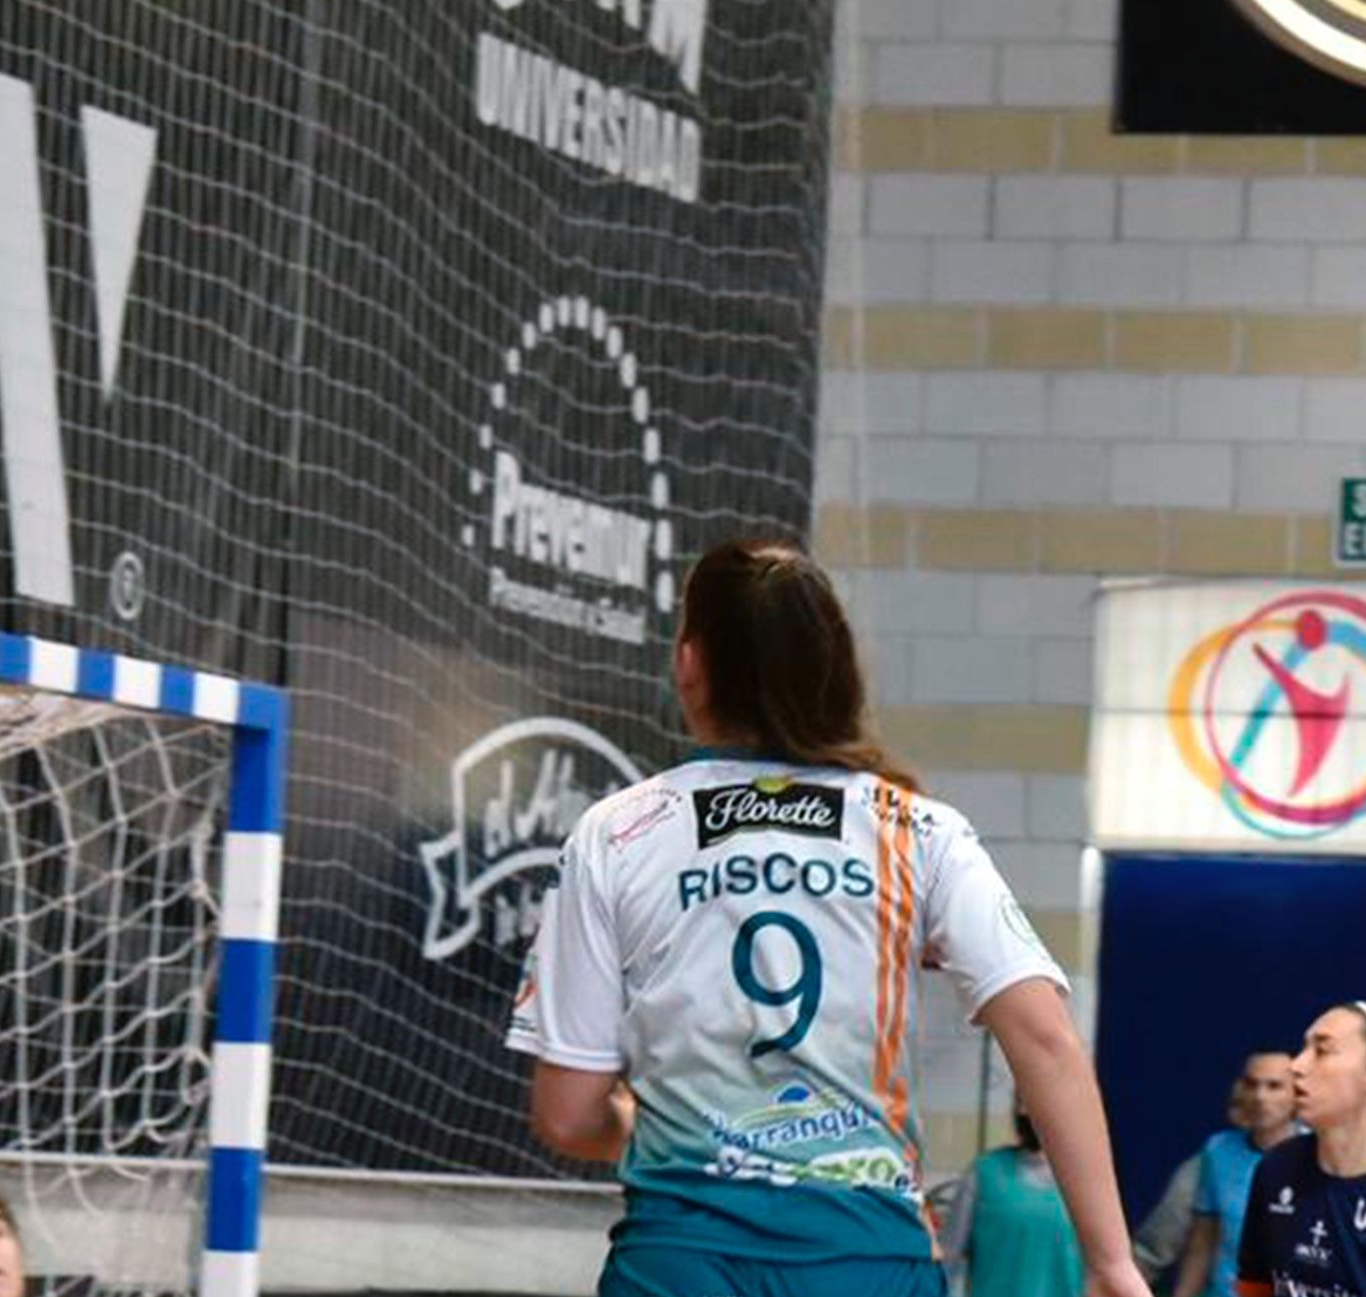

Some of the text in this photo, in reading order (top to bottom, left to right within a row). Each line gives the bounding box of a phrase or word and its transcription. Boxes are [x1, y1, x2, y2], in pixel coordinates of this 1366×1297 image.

[705, 788, 836, 830] Florette
[679, 852, 876, 911] RISCOS
[730, 910, 823, 1058] 9
